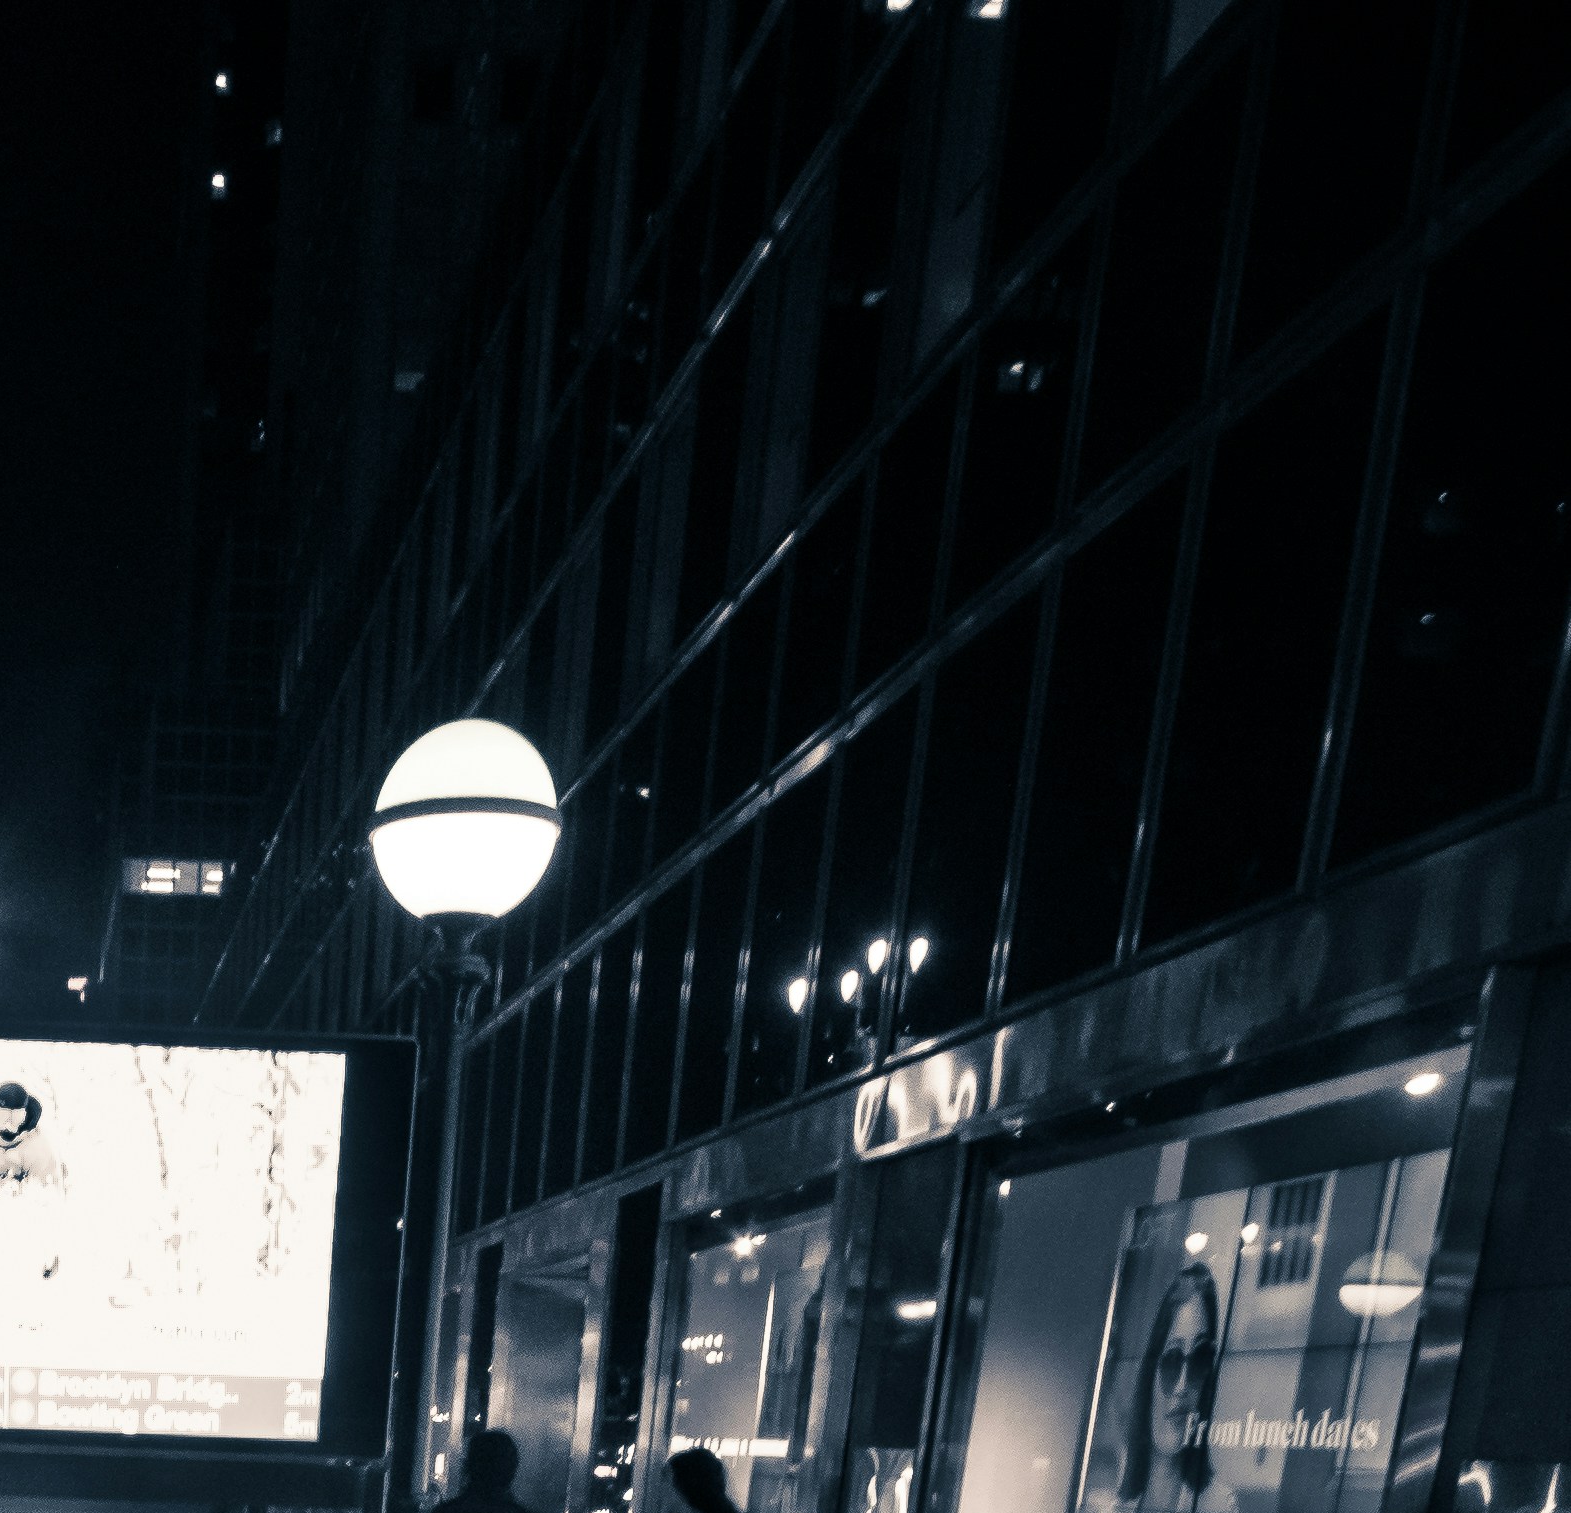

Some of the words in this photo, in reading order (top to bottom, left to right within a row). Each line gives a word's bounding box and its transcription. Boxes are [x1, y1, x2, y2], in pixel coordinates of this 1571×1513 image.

[37, 1368, 153, 1405] Brooklyn
[37, 1398, 140, 1434] Bowling
[143, 1403, 220, 1431] Green
[1184, 1411, 1244, 1449] From
[1243, 1409, 1310, 1449] lunch
[1309, 1408, 1379, 1448] dates
